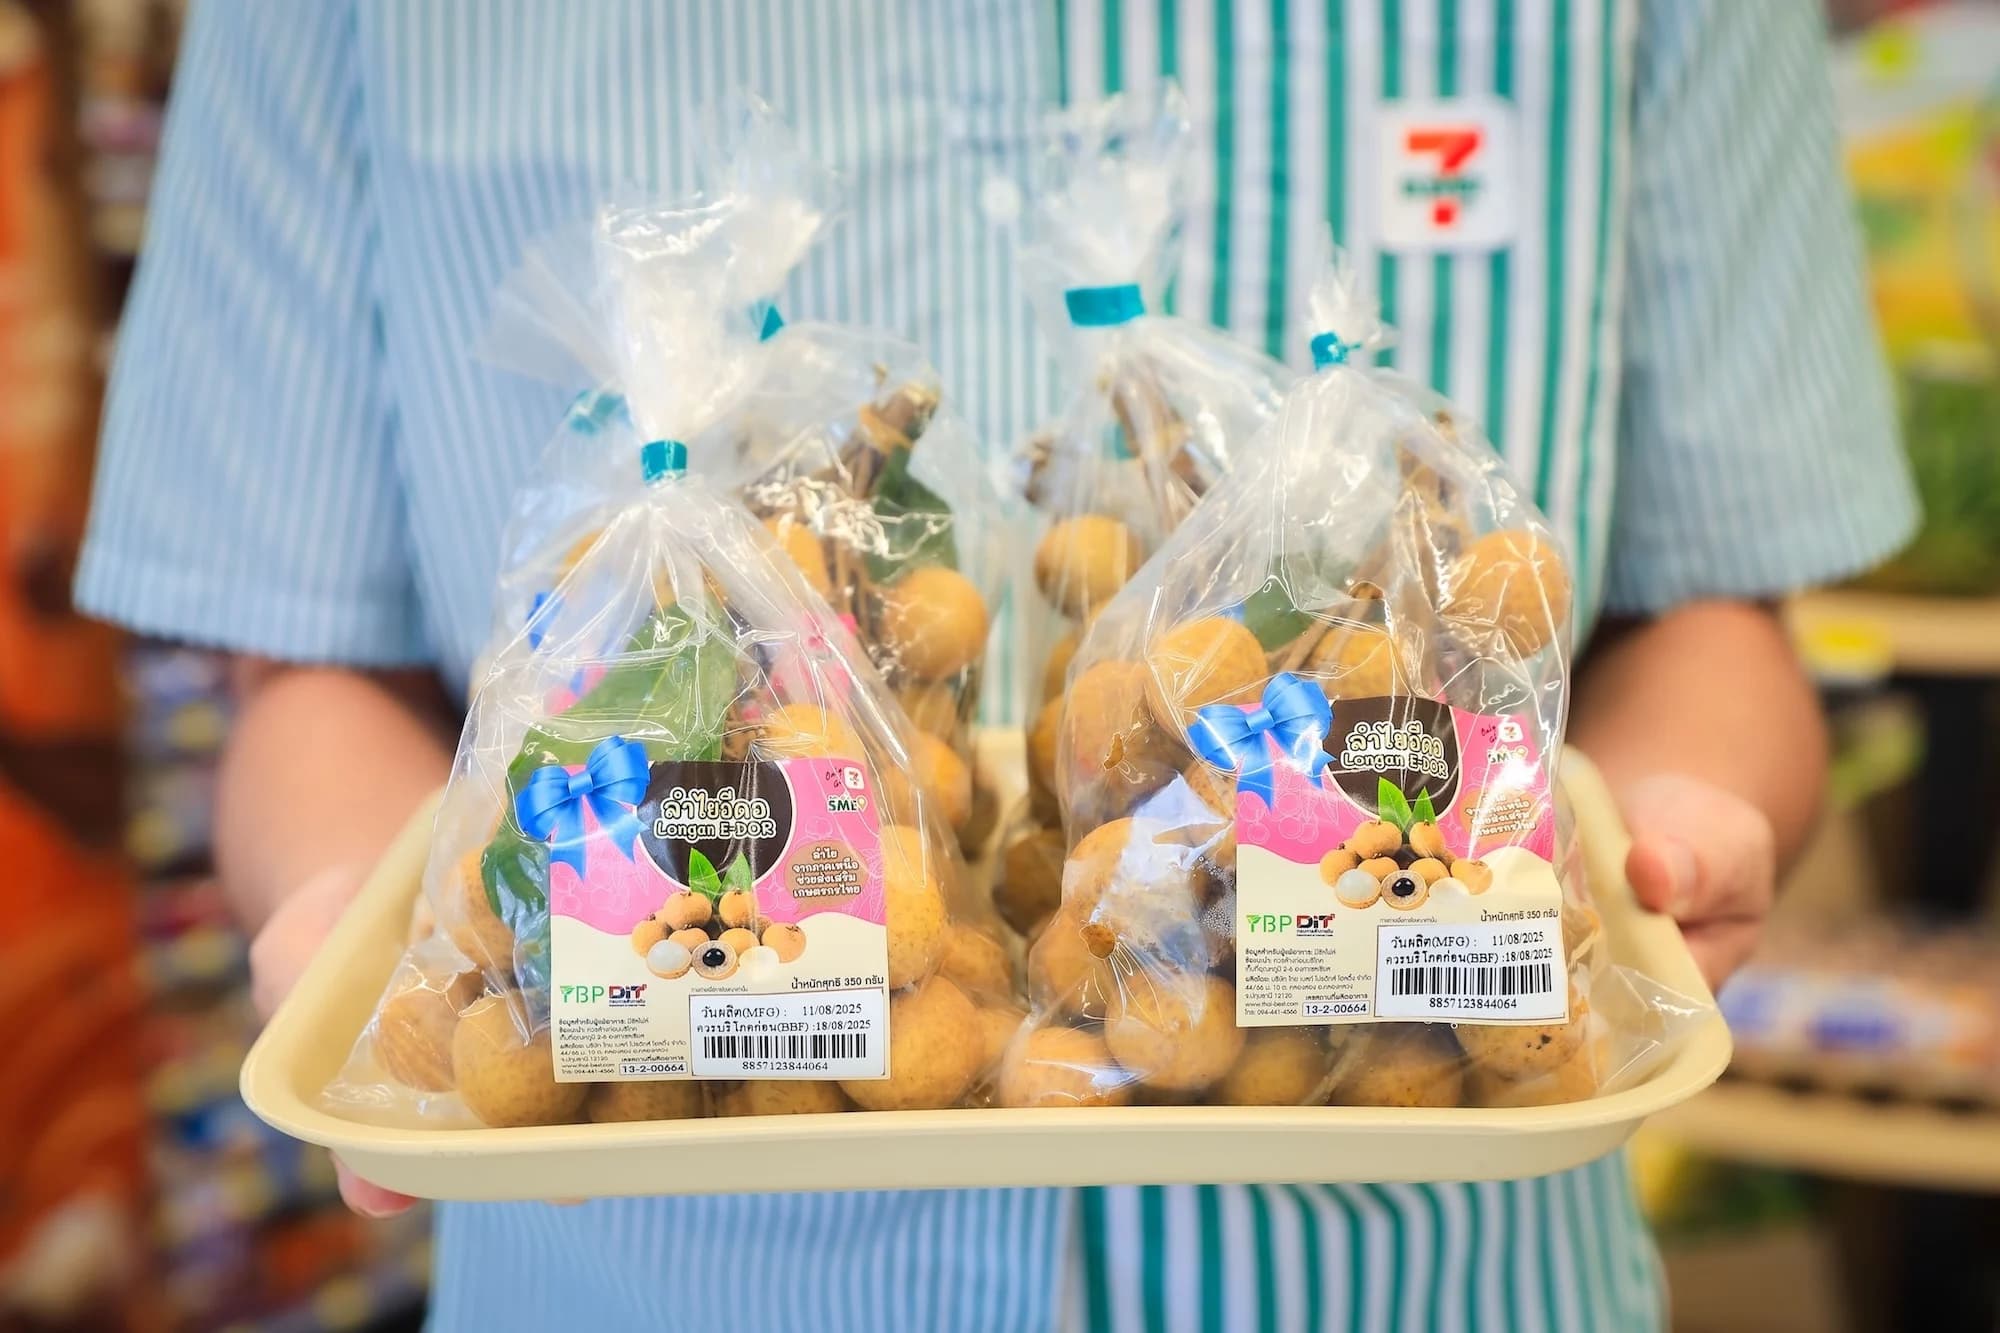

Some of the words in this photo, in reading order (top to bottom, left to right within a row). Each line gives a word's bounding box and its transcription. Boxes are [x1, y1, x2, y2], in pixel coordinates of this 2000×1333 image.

[1349, 721, 1446, 760] ลำไยอีดอ
[1343, 753, 1405, 770] Longan
[1408, 755, 1449, 777] E-DOR
[662, 788, 771, 820] ลำไยอีดอ
[656, 822, 715, 842] Longan
[719, 821, 775, 838] E-DOR
[812, 847, 838, 860] ลำไย
[792, 857, 859, 873] จากภาคเหนือ
[796, 870, 857, 885] ช่วยส่งเสริม
[793, 882, 861, 898] เกษตรกรไทย
[1526, 910, 1541, 920] 350
[1543, 908, 1559, 918] กรัม
[1391, 934, 1470, 949] วันผลิต(MFG)
[1492, 931, 1544, 946] 11/08/2025
[791, 976, 841, 991] น้ำหนักสุทธิ
[844, 976, 862, 986] 350
[865, 974, 884, 985] กรัม
[1305, 1004, 1367, 1015] 13-2-00664
[1429, 998, 1517, 1009] 8857123844064
[701, 1004, 780, 1019] วันผลิต(MFG)
[802, 1004, 862, 1016] 11/08/2025
[622, 1064, 685, 1073] 13-2-00664
[742, 1061, 829, 1071] 8857123844064
